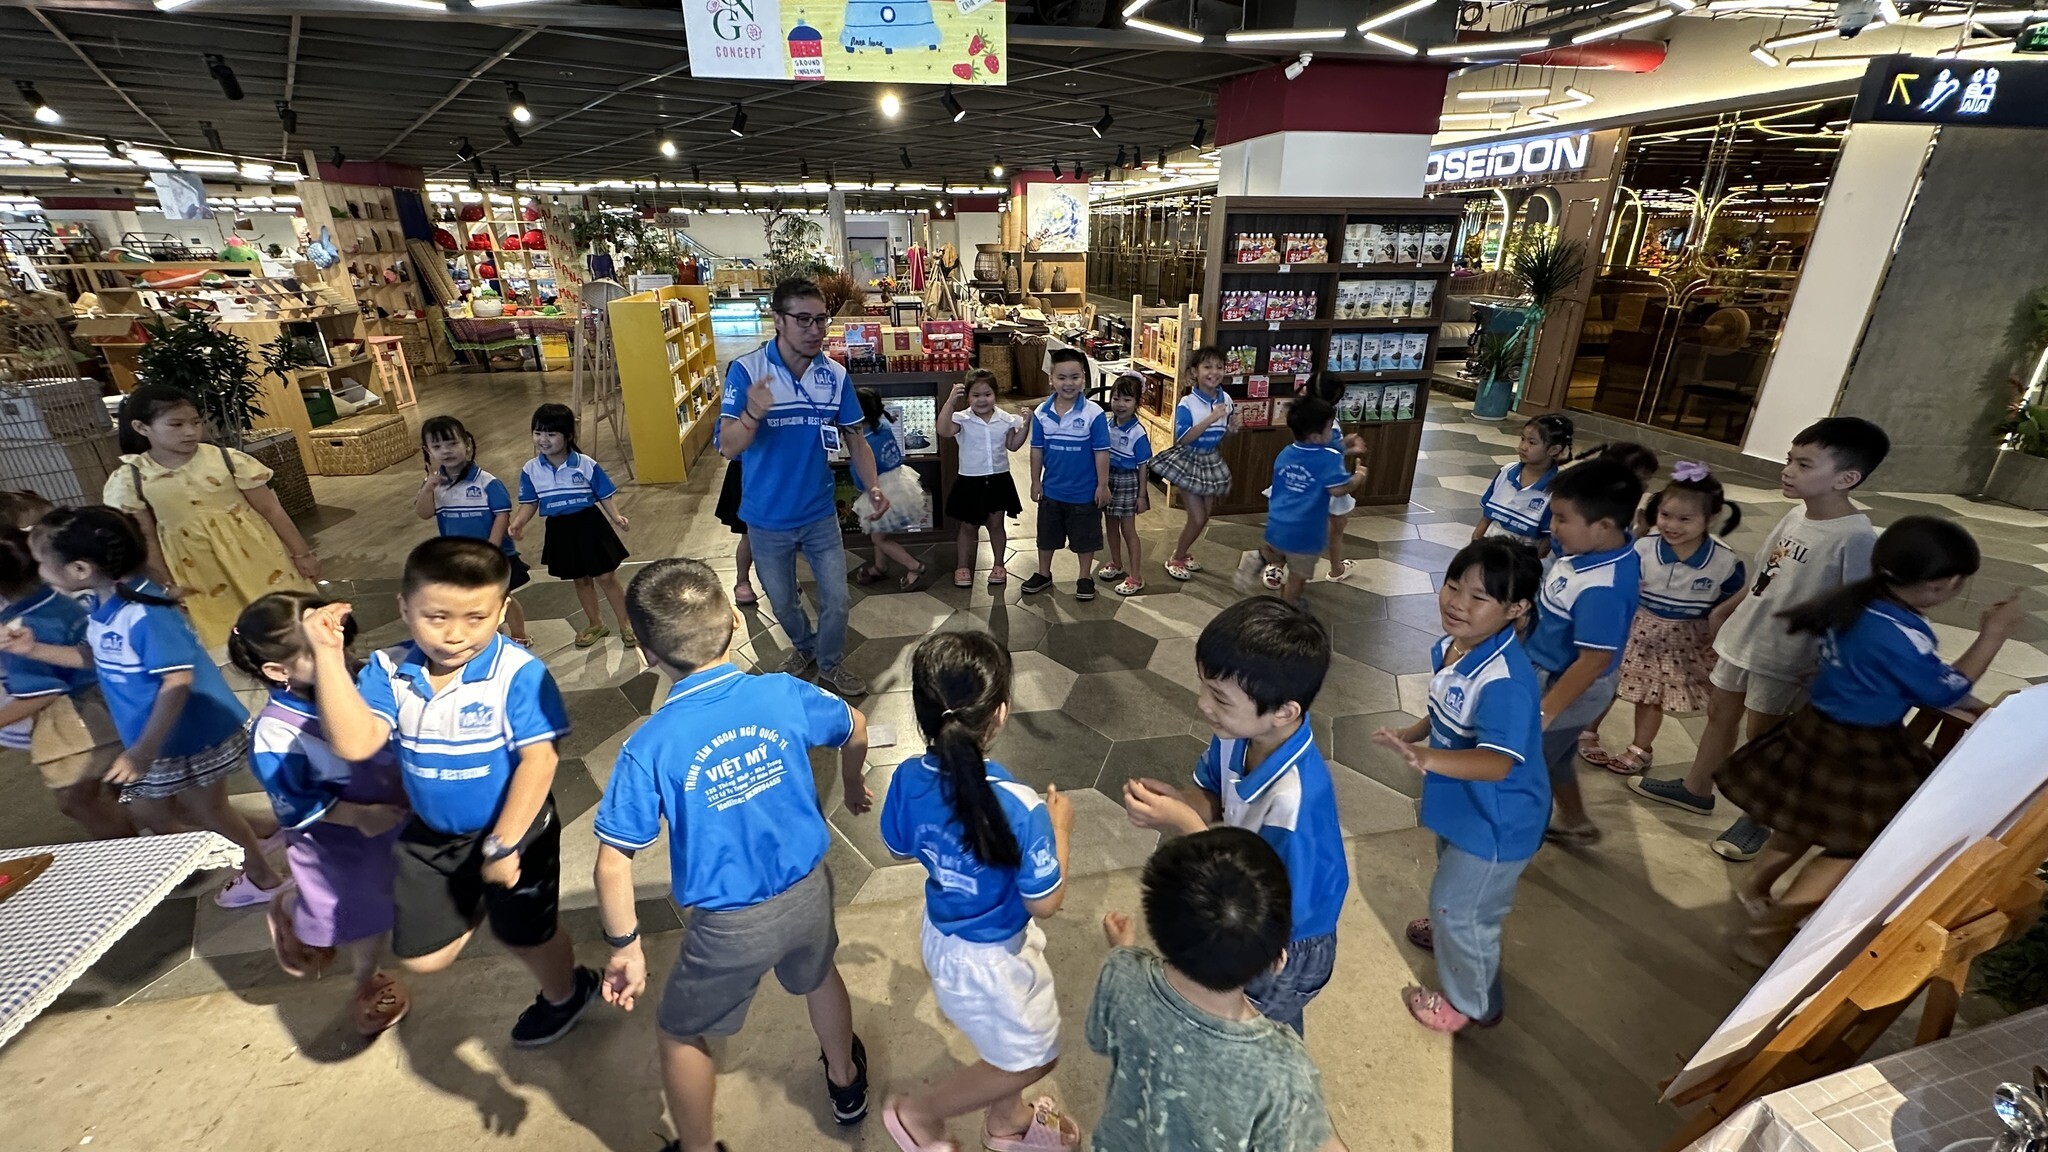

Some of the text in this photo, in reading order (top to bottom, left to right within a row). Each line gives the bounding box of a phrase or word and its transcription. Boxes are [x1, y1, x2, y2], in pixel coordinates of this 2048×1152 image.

[715, 45, 762, 59] CONCEPT
[541, 208, 567, 234] NAI
[549, 234, 574, 258] NAI
[685, 764, 701, 792] TRUNG
[711, 729, 737, 748] NGOẠI
[740, 725, 757, 737] NGỮ
[759, 727, 779, 742] QUỐC
[778, 738, 789, 751] TẾ
[705, 742, 768, 782] VIỆT MỸ
